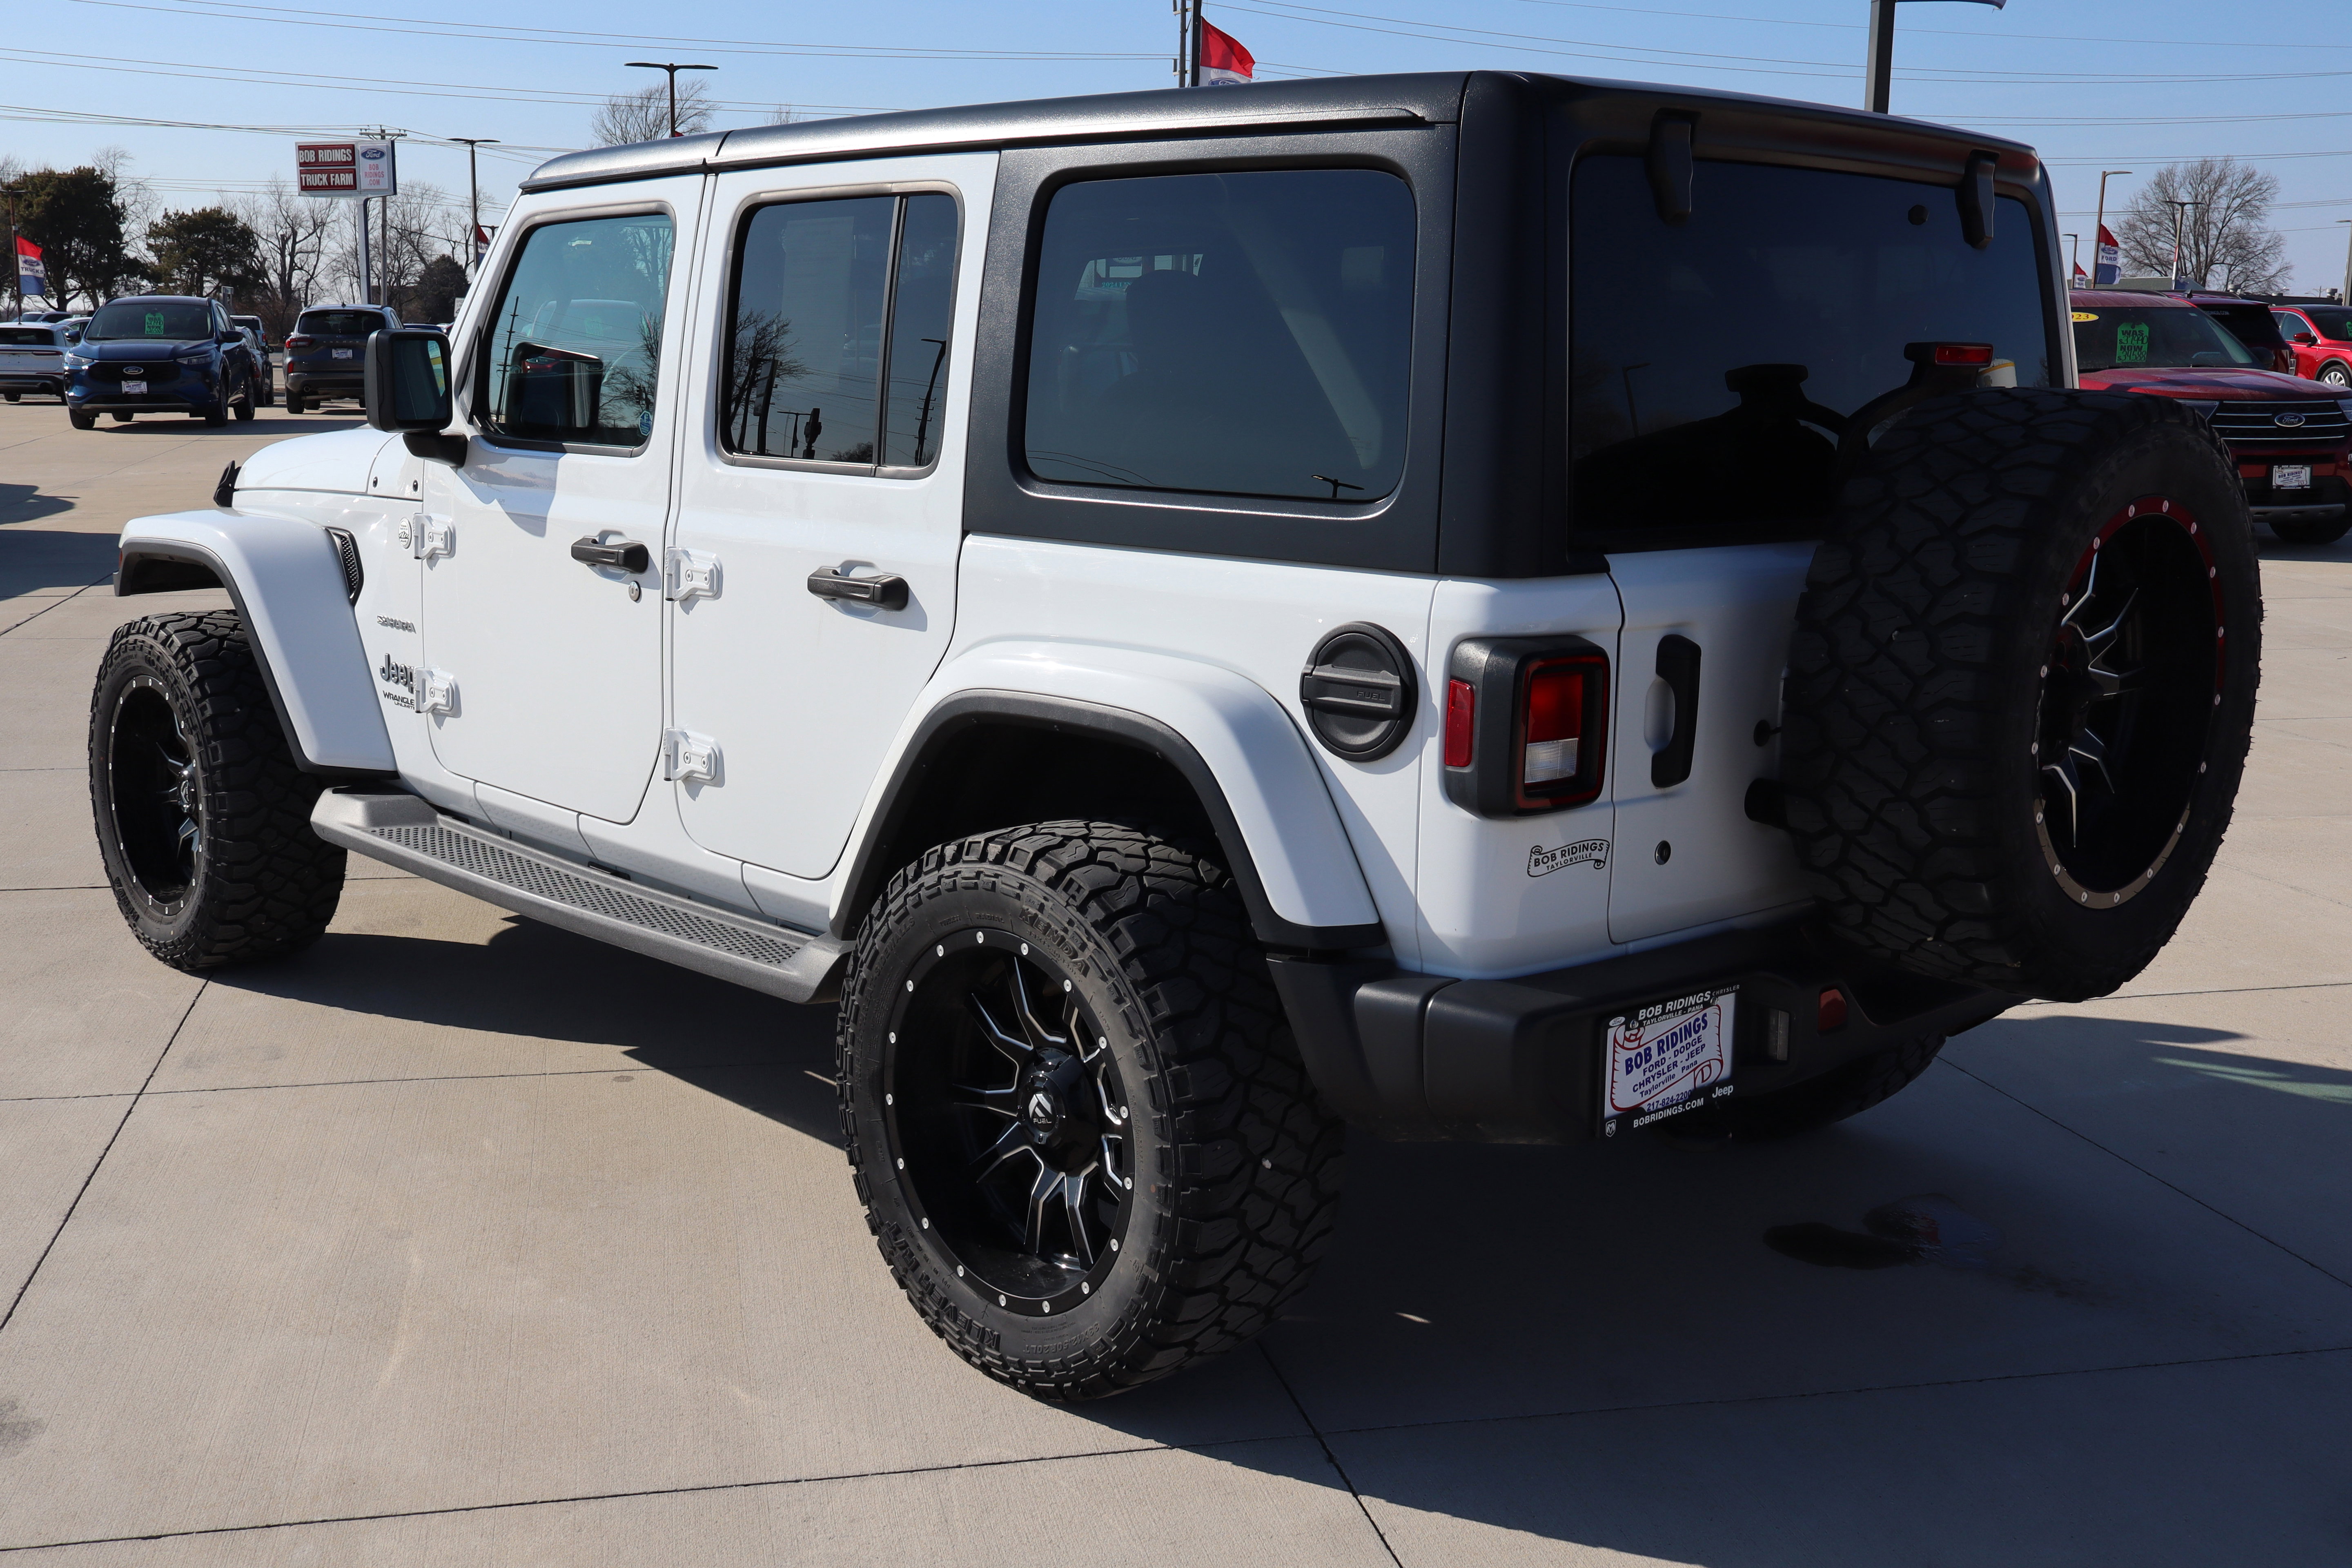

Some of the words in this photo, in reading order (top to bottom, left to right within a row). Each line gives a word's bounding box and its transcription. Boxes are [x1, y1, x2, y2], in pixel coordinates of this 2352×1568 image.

[299, 150, 316, 163] BOB
[318, 149, 352, 162] RIDINGS
[365, 149, 380, 158] Ford
[301, 174, 330, 186] TRUCK
[330, 173, 353, 185] FARM
[377, 615, 416, 634] SAHARA
[379, 653, 414, 694] Jeep
[382, 690, 415, 706] WRANGLE
[394, 701, 415, 710] UNLIMIT
[1357, 690, 1385, 701] FUEL
[1534, 853, 1557, 867] BOB
[1560, 842, 1604, 859] RIDINGS
[1546, 853, 1592, 871] TAYLORVILLE
[976, 913, 1005, 924] RADIAL
[1018, 905, 1091, 978] KENDA
[1713, 984, 1740, 996] CHRYSLER
[1638, 1004, 1662, 1020] BOB
[1666, 991, 1711, 1013] RIDINGS
[1643, 1010, 1682, 1027] TAYLORVILLE
[1688, 1004, 1703, 1013] PANA
[1625, 1046, 1652, 1076] BOB
[1657, 1012, 1708, 1057] RIDINGS
[1643, 1057, 1666, 1076] FORD
[1674, 1035, 1703, 1058] DODGE
[1633, 1061, 1678, 1093] CHRYSLER
[1685, 1043, 1706, 1062] JEEP
[1639, 1073, 1676, 1098] Taylorville
[1681, 1060, 1698, 1074] Pana
[1647, 1089, 1692, 1111] 217-824-2200
[1712, 1085, 1734, 1099] Jeep
[1633, 1097, 1704, 1128] BOBRIDINGS.COM
[918, 1271, 1001, 1352] KLEVER
